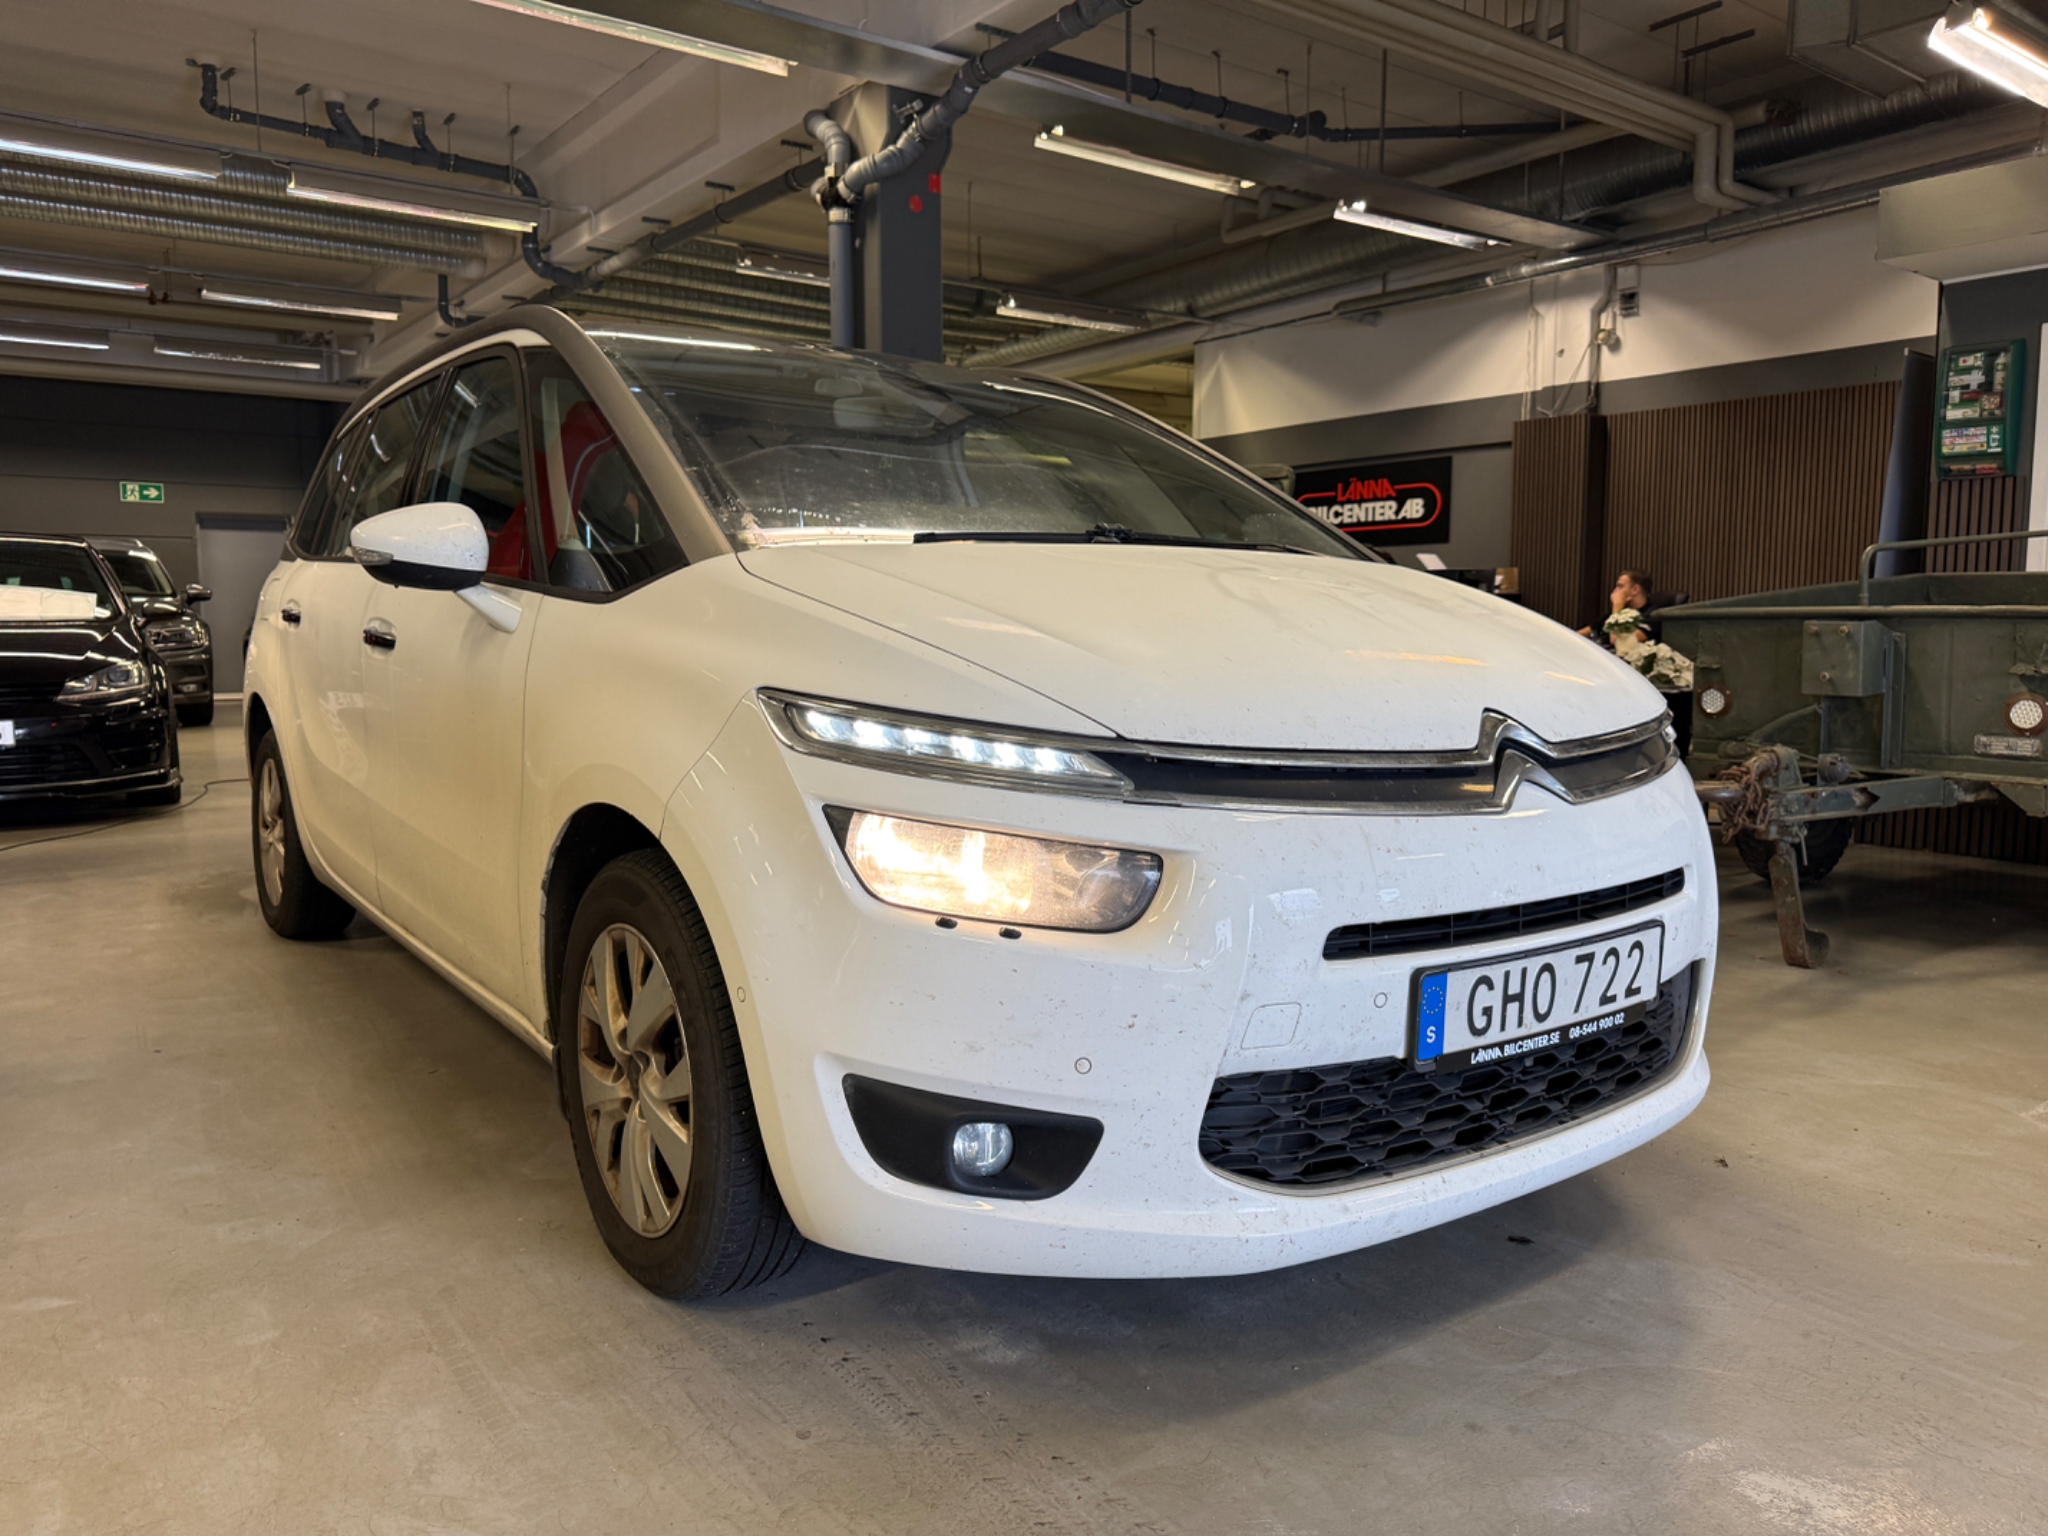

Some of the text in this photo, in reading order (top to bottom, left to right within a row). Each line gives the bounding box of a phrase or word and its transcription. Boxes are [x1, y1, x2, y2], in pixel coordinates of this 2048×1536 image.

[1337, 478, 1397, 502] LÄNNA
[1397, 498, 1425, 519] AB
[1467, 940, 1645, 1038] GHO 722
[1426, 1025, 1436, 1044] S
[1470, 1046, 1503, 1064] LÄNNA
[1504, 1031, 1561, 1057] BILCENTER.SE
[1614, 1012, 1625, 1025] 02
